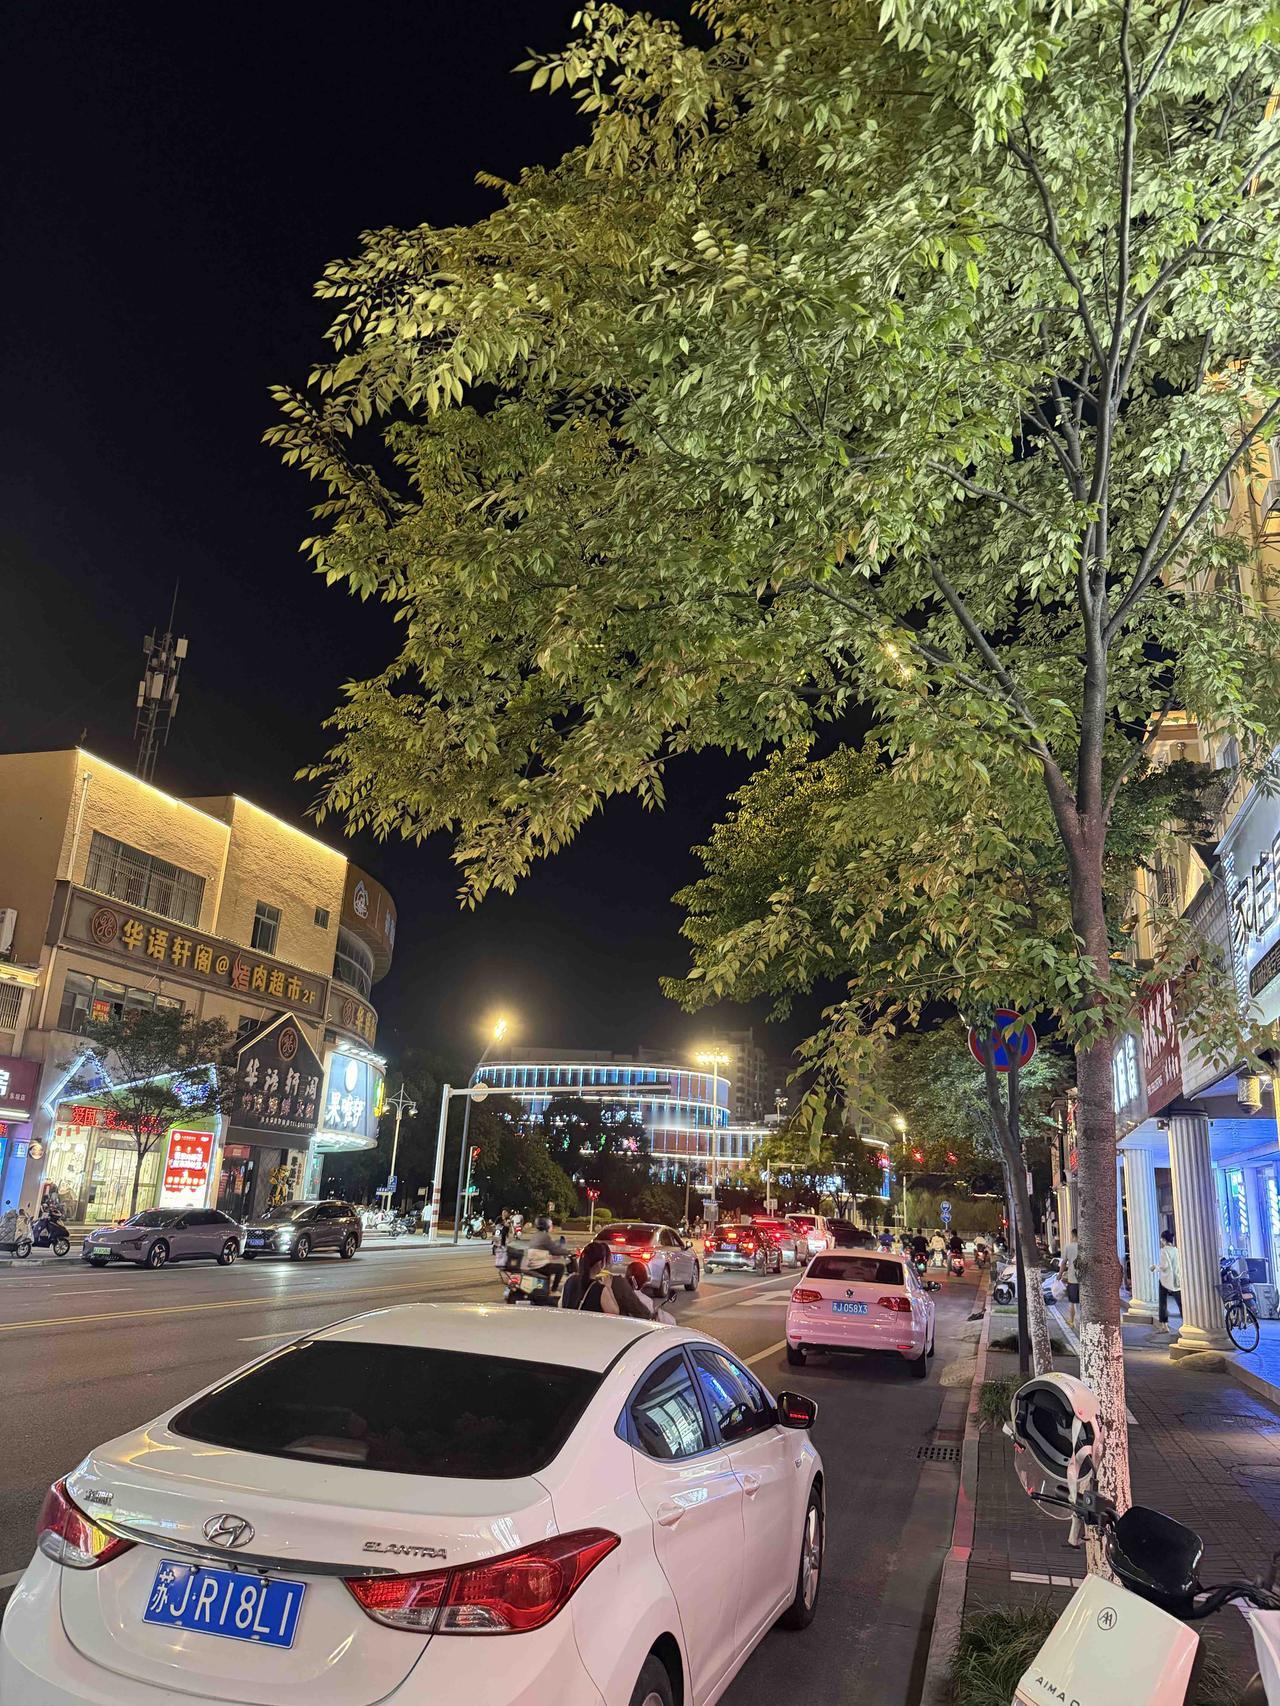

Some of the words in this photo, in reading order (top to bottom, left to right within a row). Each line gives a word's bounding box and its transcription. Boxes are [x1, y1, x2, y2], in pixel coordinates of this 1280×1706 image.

[244, 1058, 319, 1099] 华语轩阁
[362, 1541, 447, 1560] ELANTRA
[1035, 1676, 1066, 1702] AIMA
